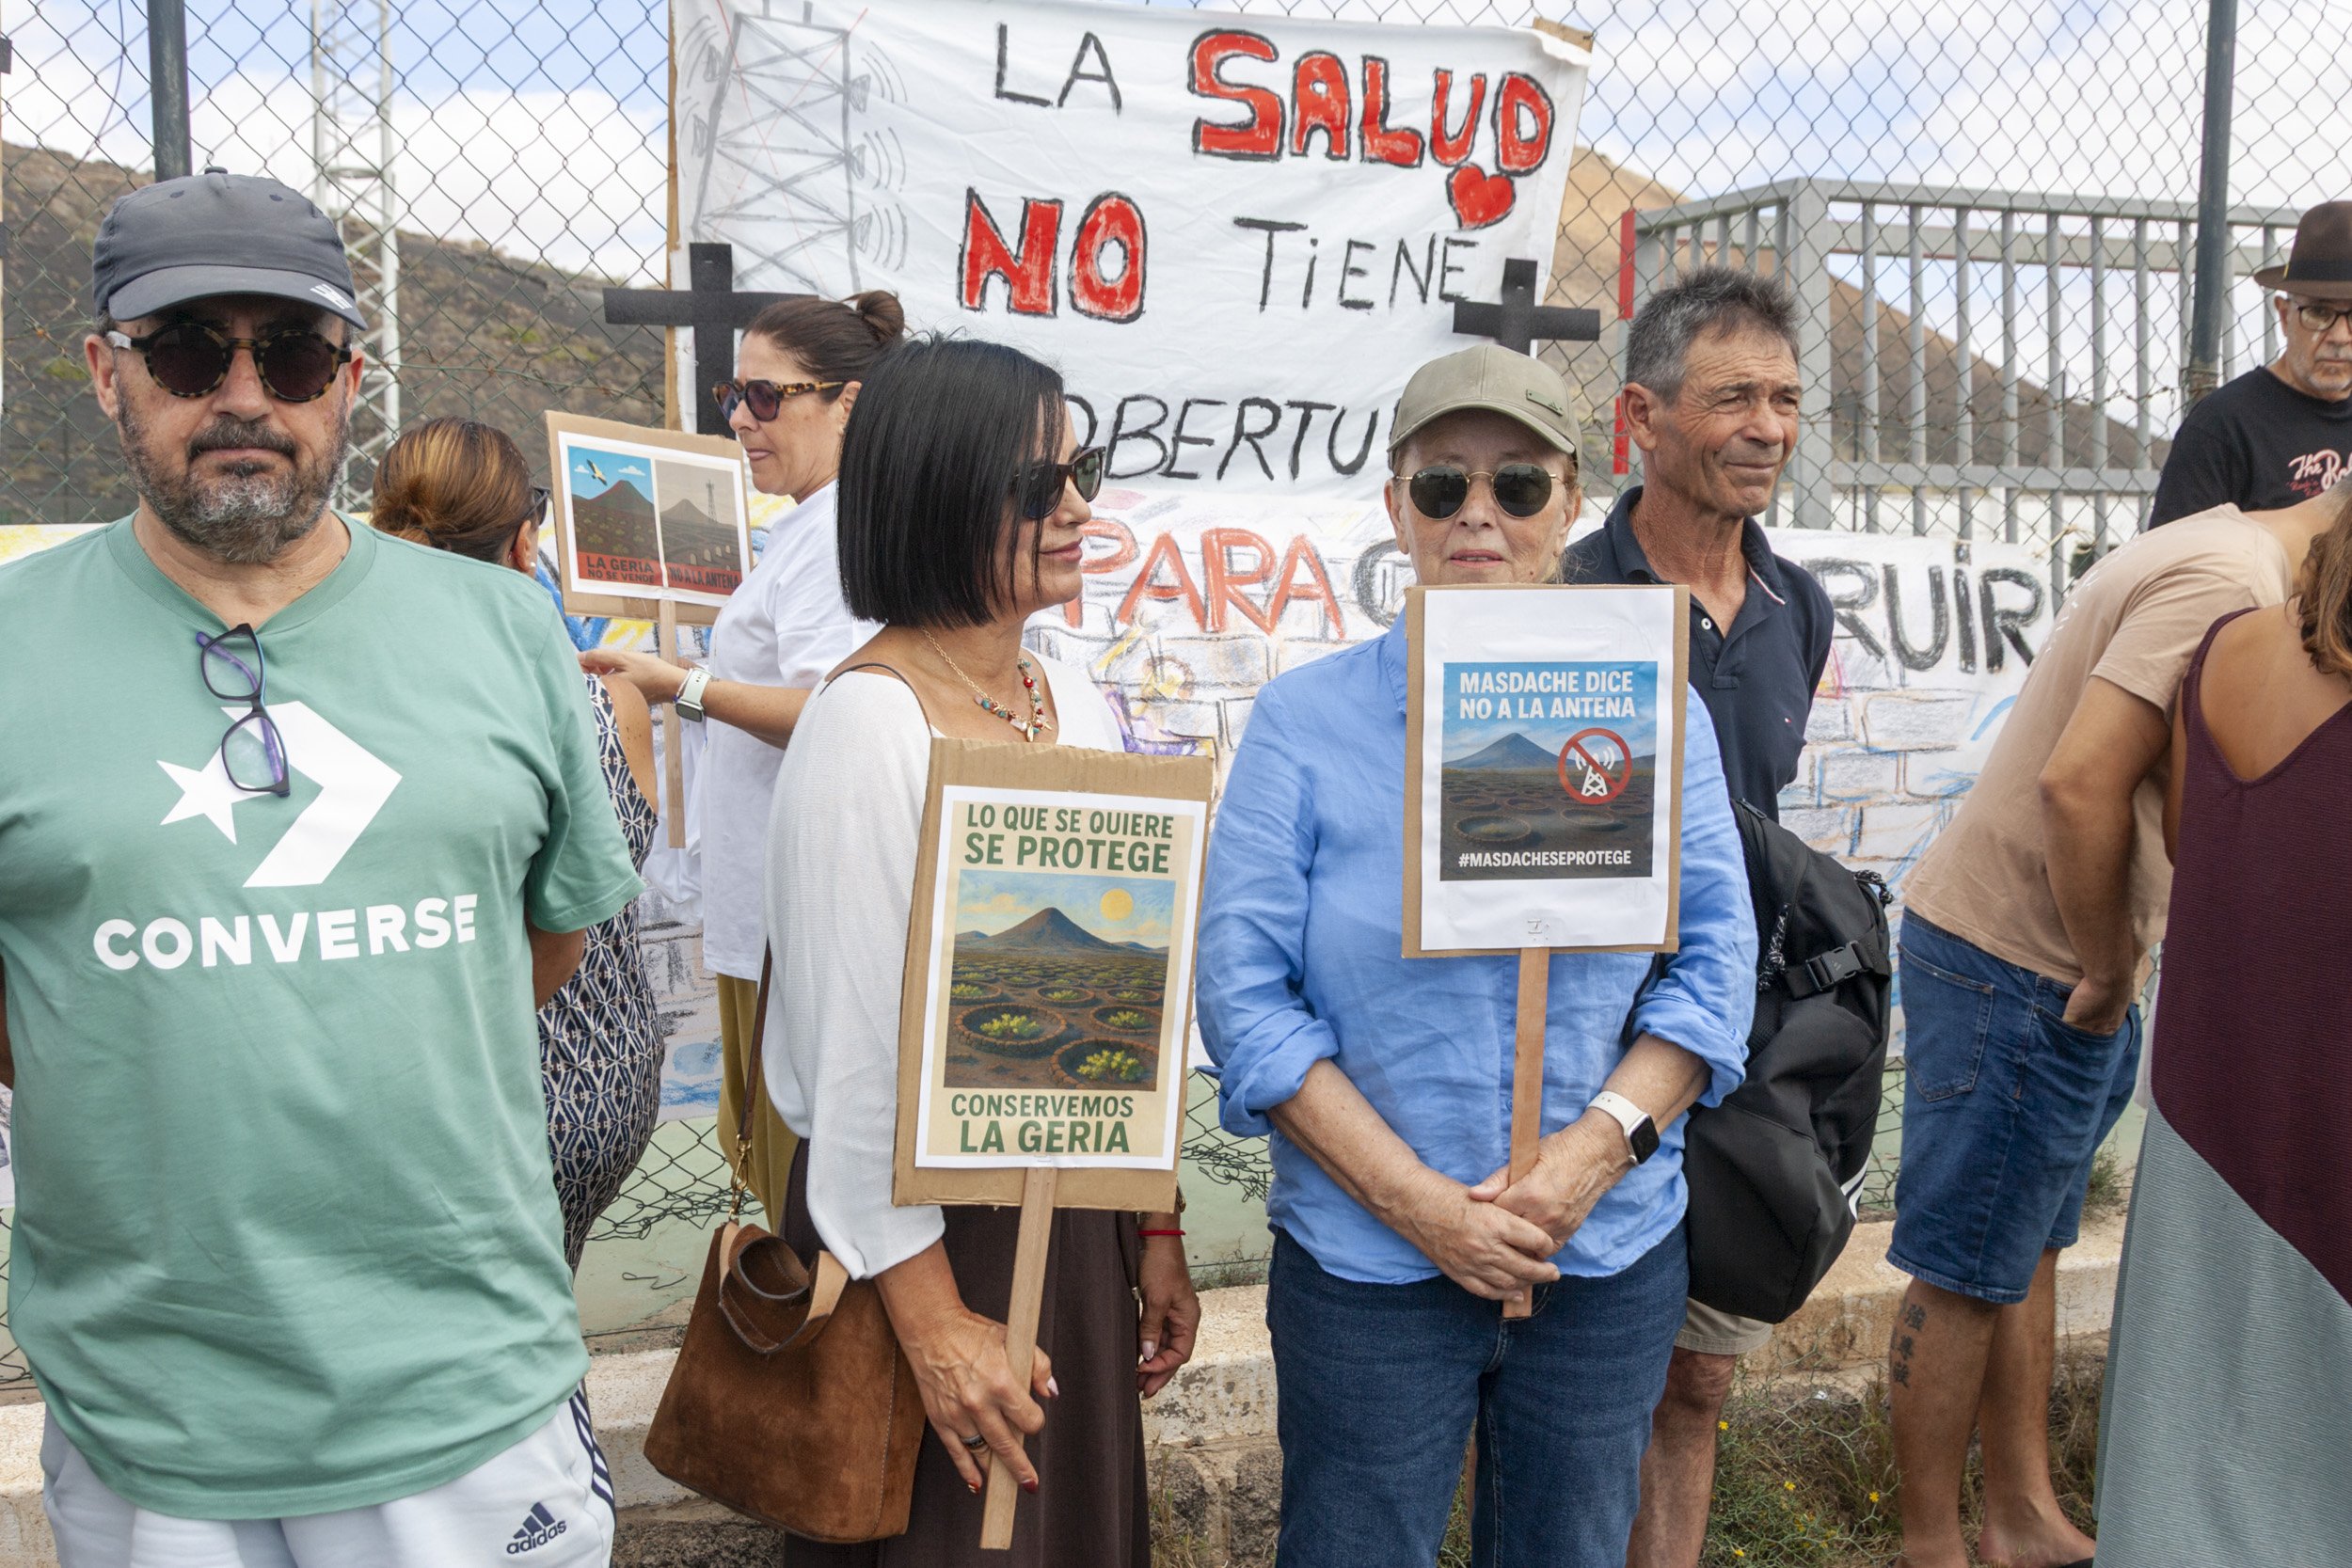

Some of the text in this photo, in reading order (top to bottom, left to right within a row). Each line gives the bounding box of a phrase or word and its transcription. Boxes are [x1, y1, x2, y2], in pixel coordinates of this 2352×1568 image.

[995, 23, 1556, 177] LA SALUD
[959, 187, 1148, 324] NO
[2288, 453, 2323, 480] The
[586, 556, 654, 573] LA GERIA
[587, 569, 655, 583] NO SE VENDE
[669, 566, 740, 590] NO A LA ANTENA
[1063, 517, 1346, 640] PARA
[1460, 671, 1633, 694] MASDACHE DICE
[1459, 696, 1636, 720] NO A LA ANTENA
[967, 804, 1174, 838] LO QUE SE QUIERE
[964, 832, 1170, 874] SE PROTEGE
[1458, 850, 1631, 868] #MASDACHESEPROTEGE
[93, 894, 478, 971] CONVERSE
[951, 1094, 1134, 1117] CONSERVEMOS
[960, 1120, 1130, 1153] LA GERIA
[506, 1520, 567, 1555] adidas
